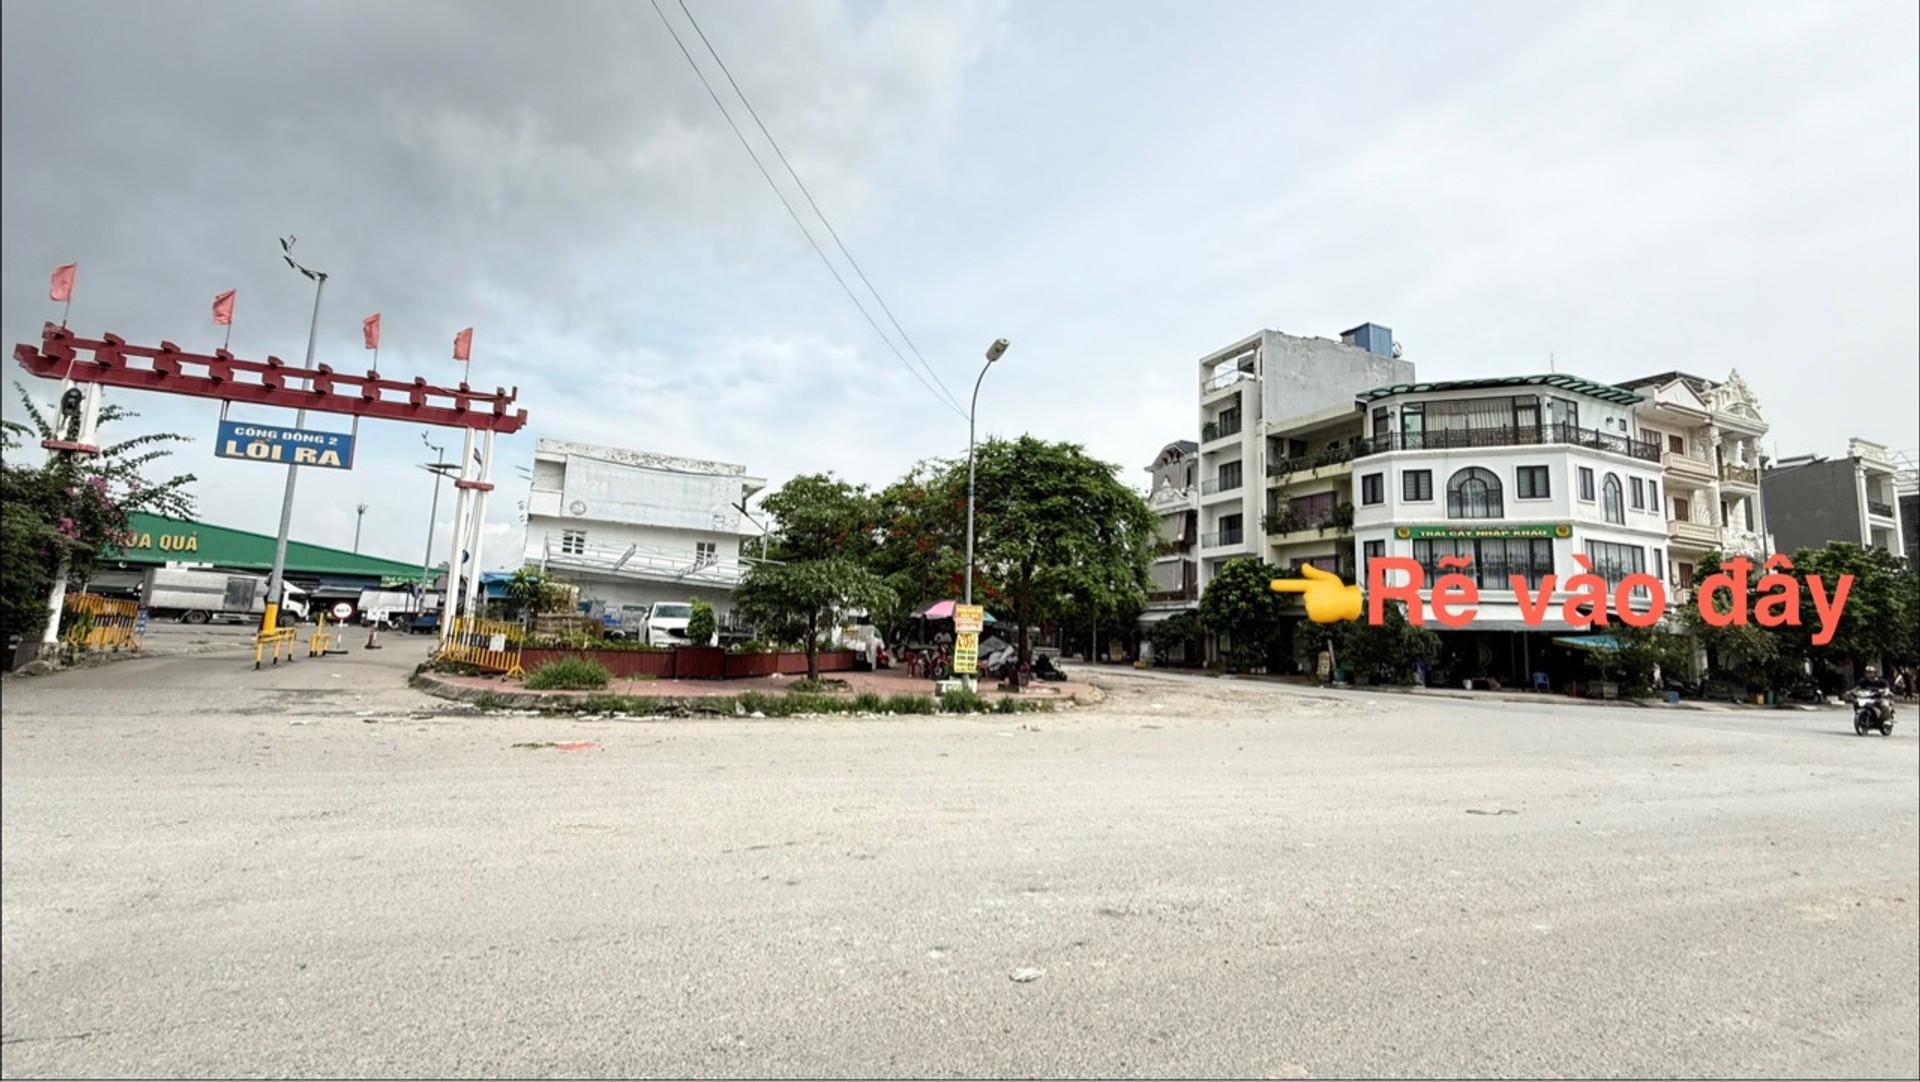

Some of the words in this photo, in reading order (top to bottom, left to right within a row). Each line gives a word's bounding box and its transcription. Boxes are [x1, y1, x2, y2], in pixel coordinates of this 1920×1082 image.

[328, 436, 339, 446] 2
[294, 446, 341, 467] RA
[159, 531, 198, 551] QUẢ
